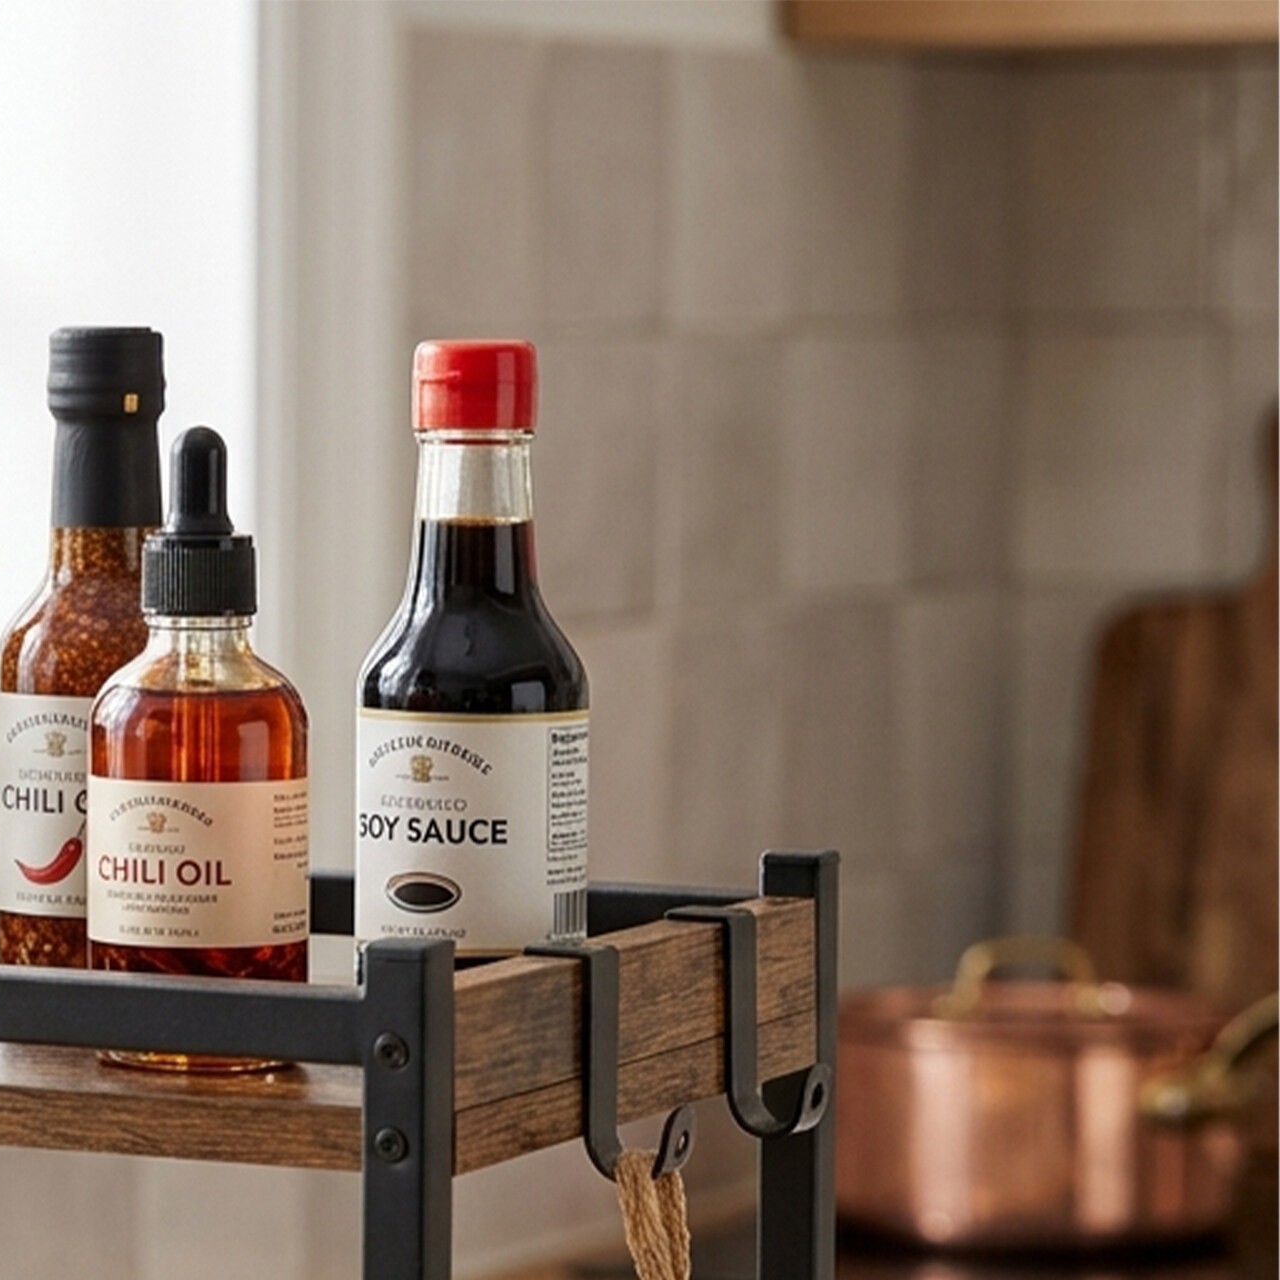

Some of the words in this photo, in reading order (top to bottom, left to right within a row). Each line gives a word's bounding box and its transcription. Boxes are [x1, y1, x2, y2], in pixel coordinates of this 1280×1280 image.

[2, 784, 63, 814] CHILI
[359, 812, 400, 841] SOY
[407, 817, 508, 844] SAUCE
[98, 854, 165, 885] CHILI
[176, 859, 232, 886] OIL
